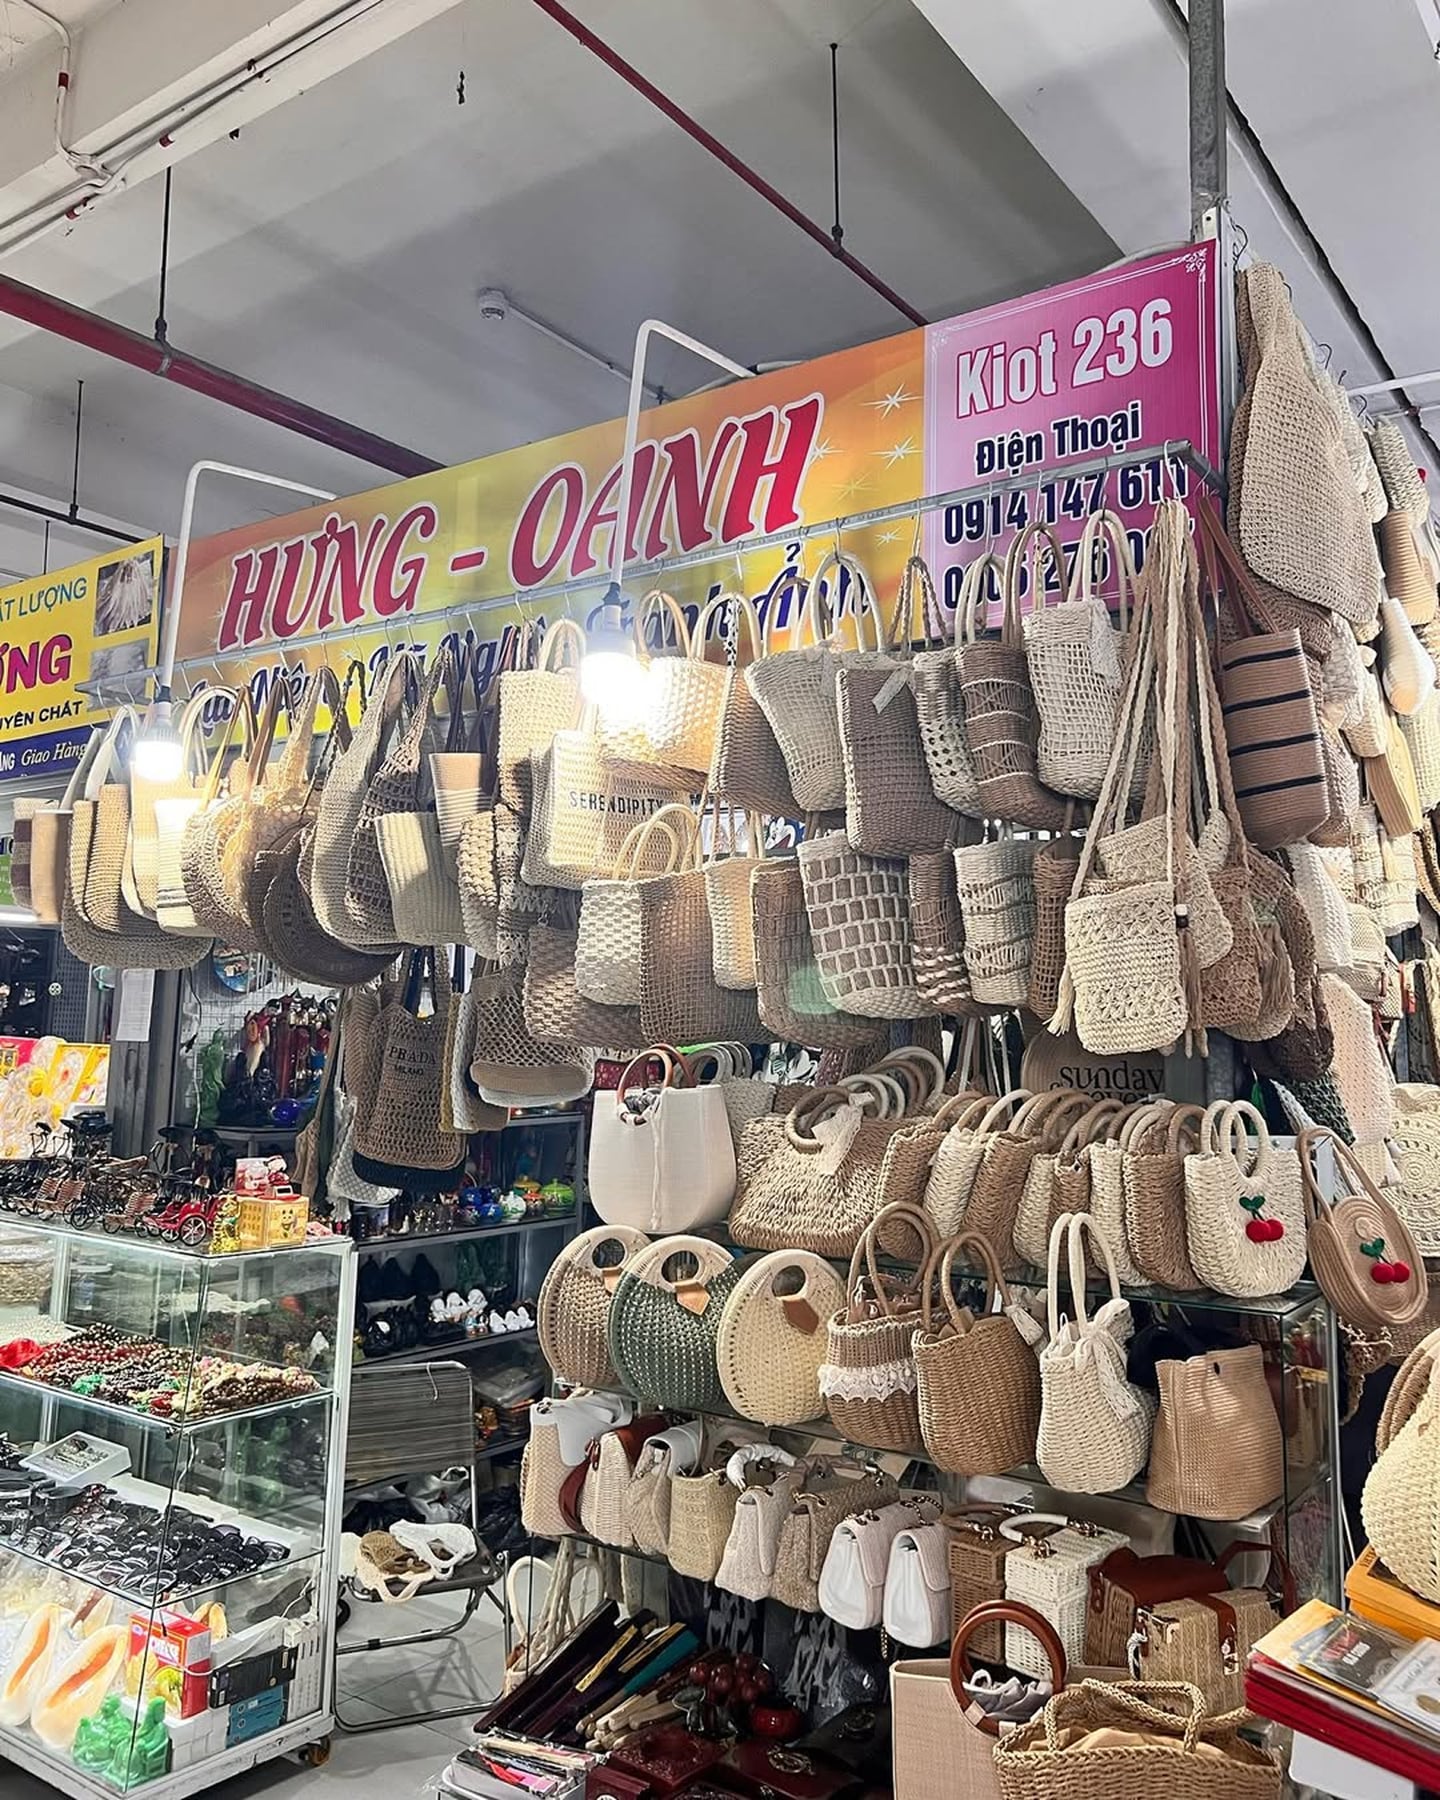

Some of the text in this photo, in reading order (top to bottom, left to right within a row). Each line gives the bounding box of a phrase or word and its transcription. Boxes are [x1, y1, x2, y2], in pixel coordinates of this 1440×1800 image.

[958, 297, 1174, 418] Kiot 236
[976, 402, 1142, 475] Điện Thoại
[218, 502, 438, 651] HƯNG
[511, 393, 824, 587] OANH
[944, 457, 1189, 545] 0914 147 611
[19, 576, 88, 616] LƯỢNG
[0, 634, 73, 694] NG
[21, 748, 51, 766] Giao
[53, 741, 88, 760] Hàng
[569, 790, 664, 816] SERENDIPITY
[1059, 1060, 1164, 1095] sunday
